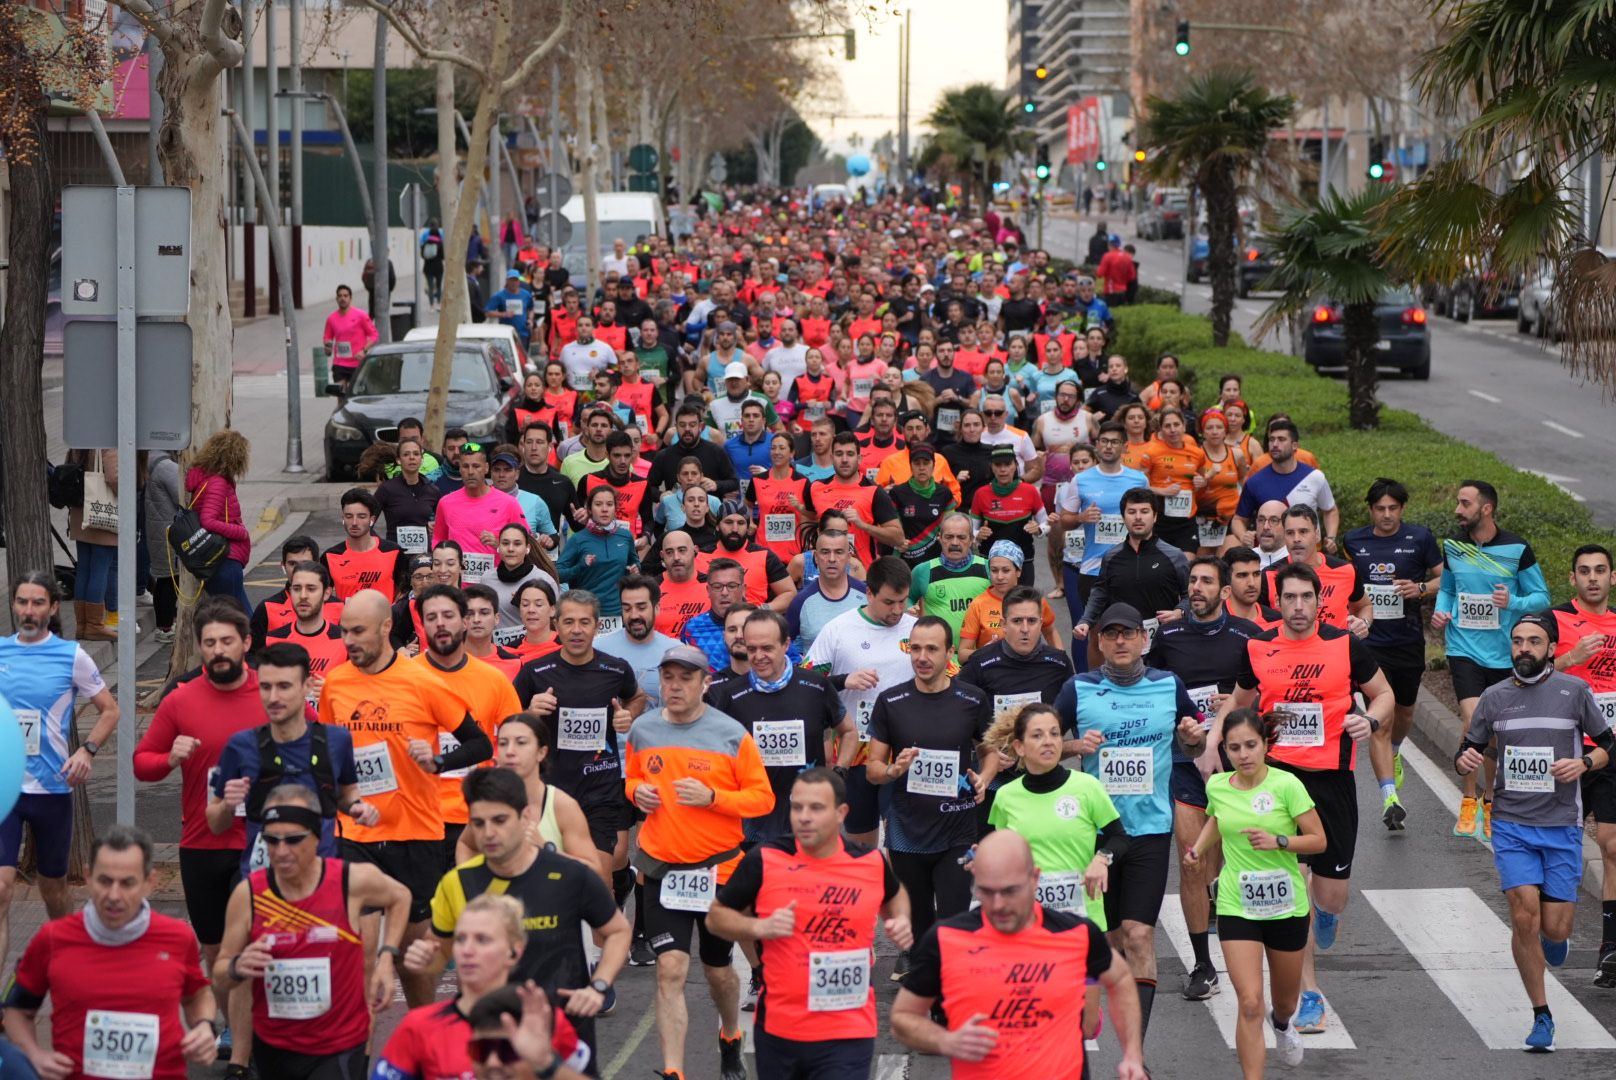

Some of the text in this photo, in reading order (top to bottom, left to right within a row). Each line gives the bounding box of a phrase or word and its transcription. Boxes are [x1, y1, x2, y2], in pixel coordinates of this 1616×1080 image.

[767, 521, 792, 531] 3979
[1098, 522, 1125, 533] 3417
[400, 533, 425, 543] 3525
[1068, 537, 1086, 547] 351
[463, 560, 490, 571] 3346
[1369, 563, 1396, 574] 200
[358, 571, 381, 583] RUN
[1368, 593, 1399, 606] 2662
[679, 603, 706, 614] RUN
[1461, 602, 1493, 616] 3602
[1602, 636, 1616, 648] RU
[1290, 664, 1326, 680] RUN
[1283, 687, 1316, 702] LIFE
[563, 719, 601, 734] 3290
[1120, 718, 1148, 730] JUST
[1280, 714, 1319, 730] 4044
[758, 732, 799, 749] 3385
[1104, 729, 1131, 741] KEEP
[1117, 732, 1164, 748] RUNNING
[914, 760, 953, 779] 3195
[1103, 759, 1148, 777] 4066
[1508, 758, 1548, 775] 4040
[921, 776, 944, 785] VICTOR
[1108, 776, 1143, 784] SANTIAGO
[667, 873, 709, 894] 3148
[1245, 881, 1288, 900] 3416
[676, 891, 698, 899] PATER
[818, 886, 862, 906] RUN
[1035, 883, 1076, 904] 3637
[1251, 898, 1283, 907] PATRICIA
[803, 915, 849, 936] LIFE
[815, 966, 863, 988] 3468
[1004, 963, 1057, 985] RUN
[271, 975, 320, 996] 2891
[990, 998, 1042, 1021] LIFE
[91, 1028, 149, 1055] 3507
